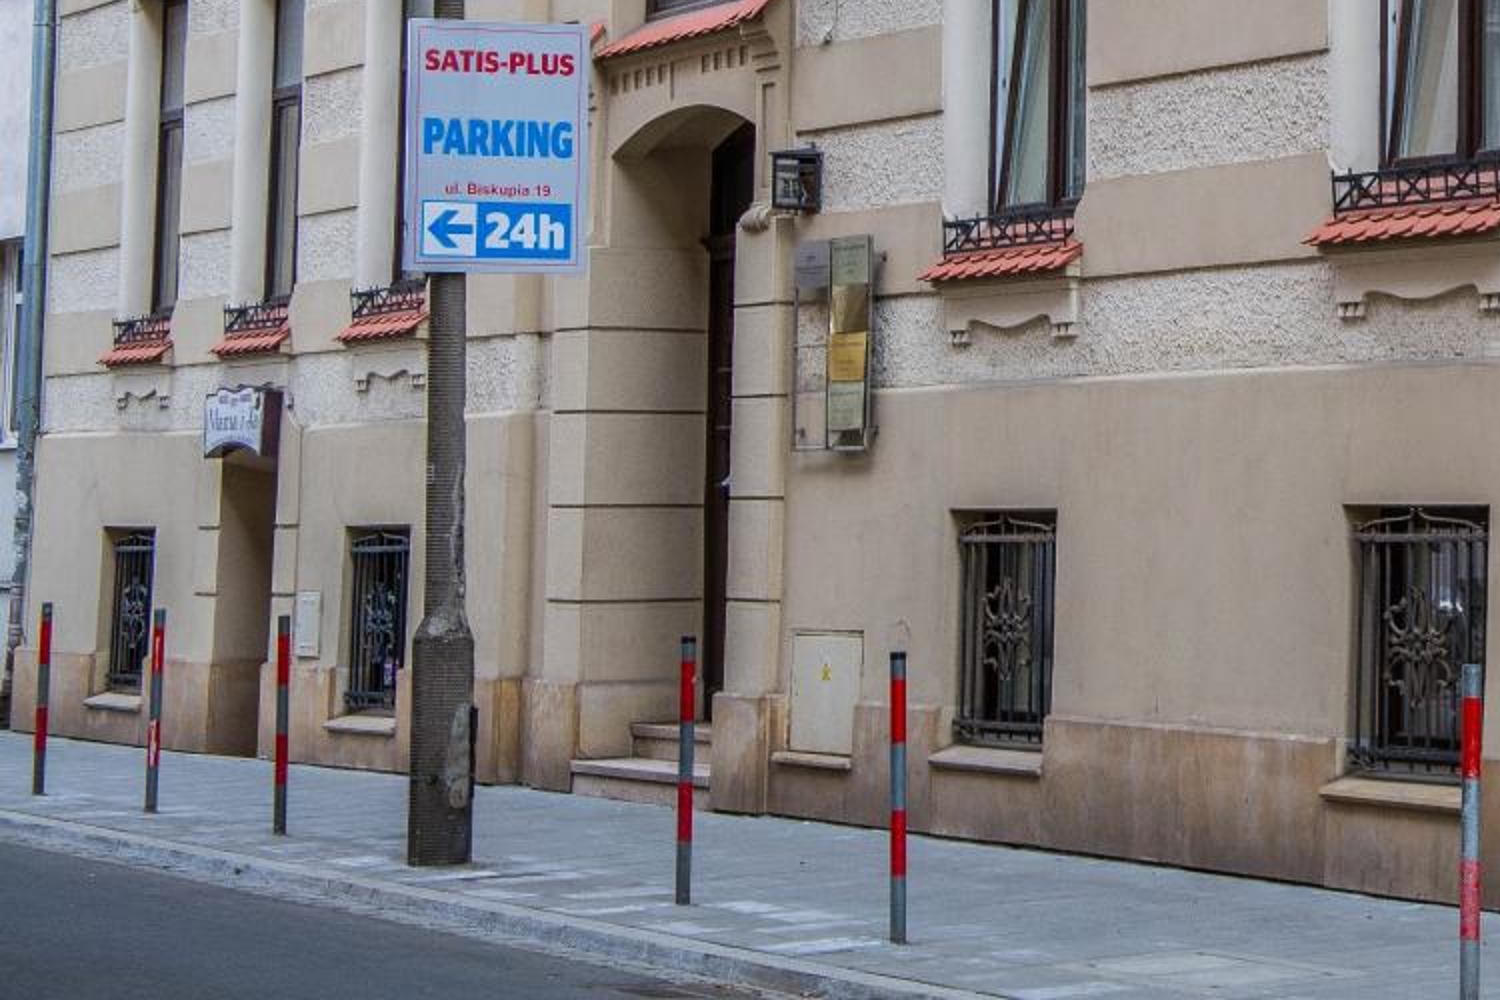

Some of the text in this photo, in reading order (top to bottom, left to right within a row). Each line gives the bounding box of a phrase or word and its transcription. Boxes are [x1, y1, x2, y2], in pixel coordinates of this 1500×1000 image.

[424, 48, 576, 77] SATIS-PLUS
[423, 116, 574, 159] PARKING
[445, 183, 552, 198] ul. Biskupia 19
[484, 211, 566, 250] 24h
